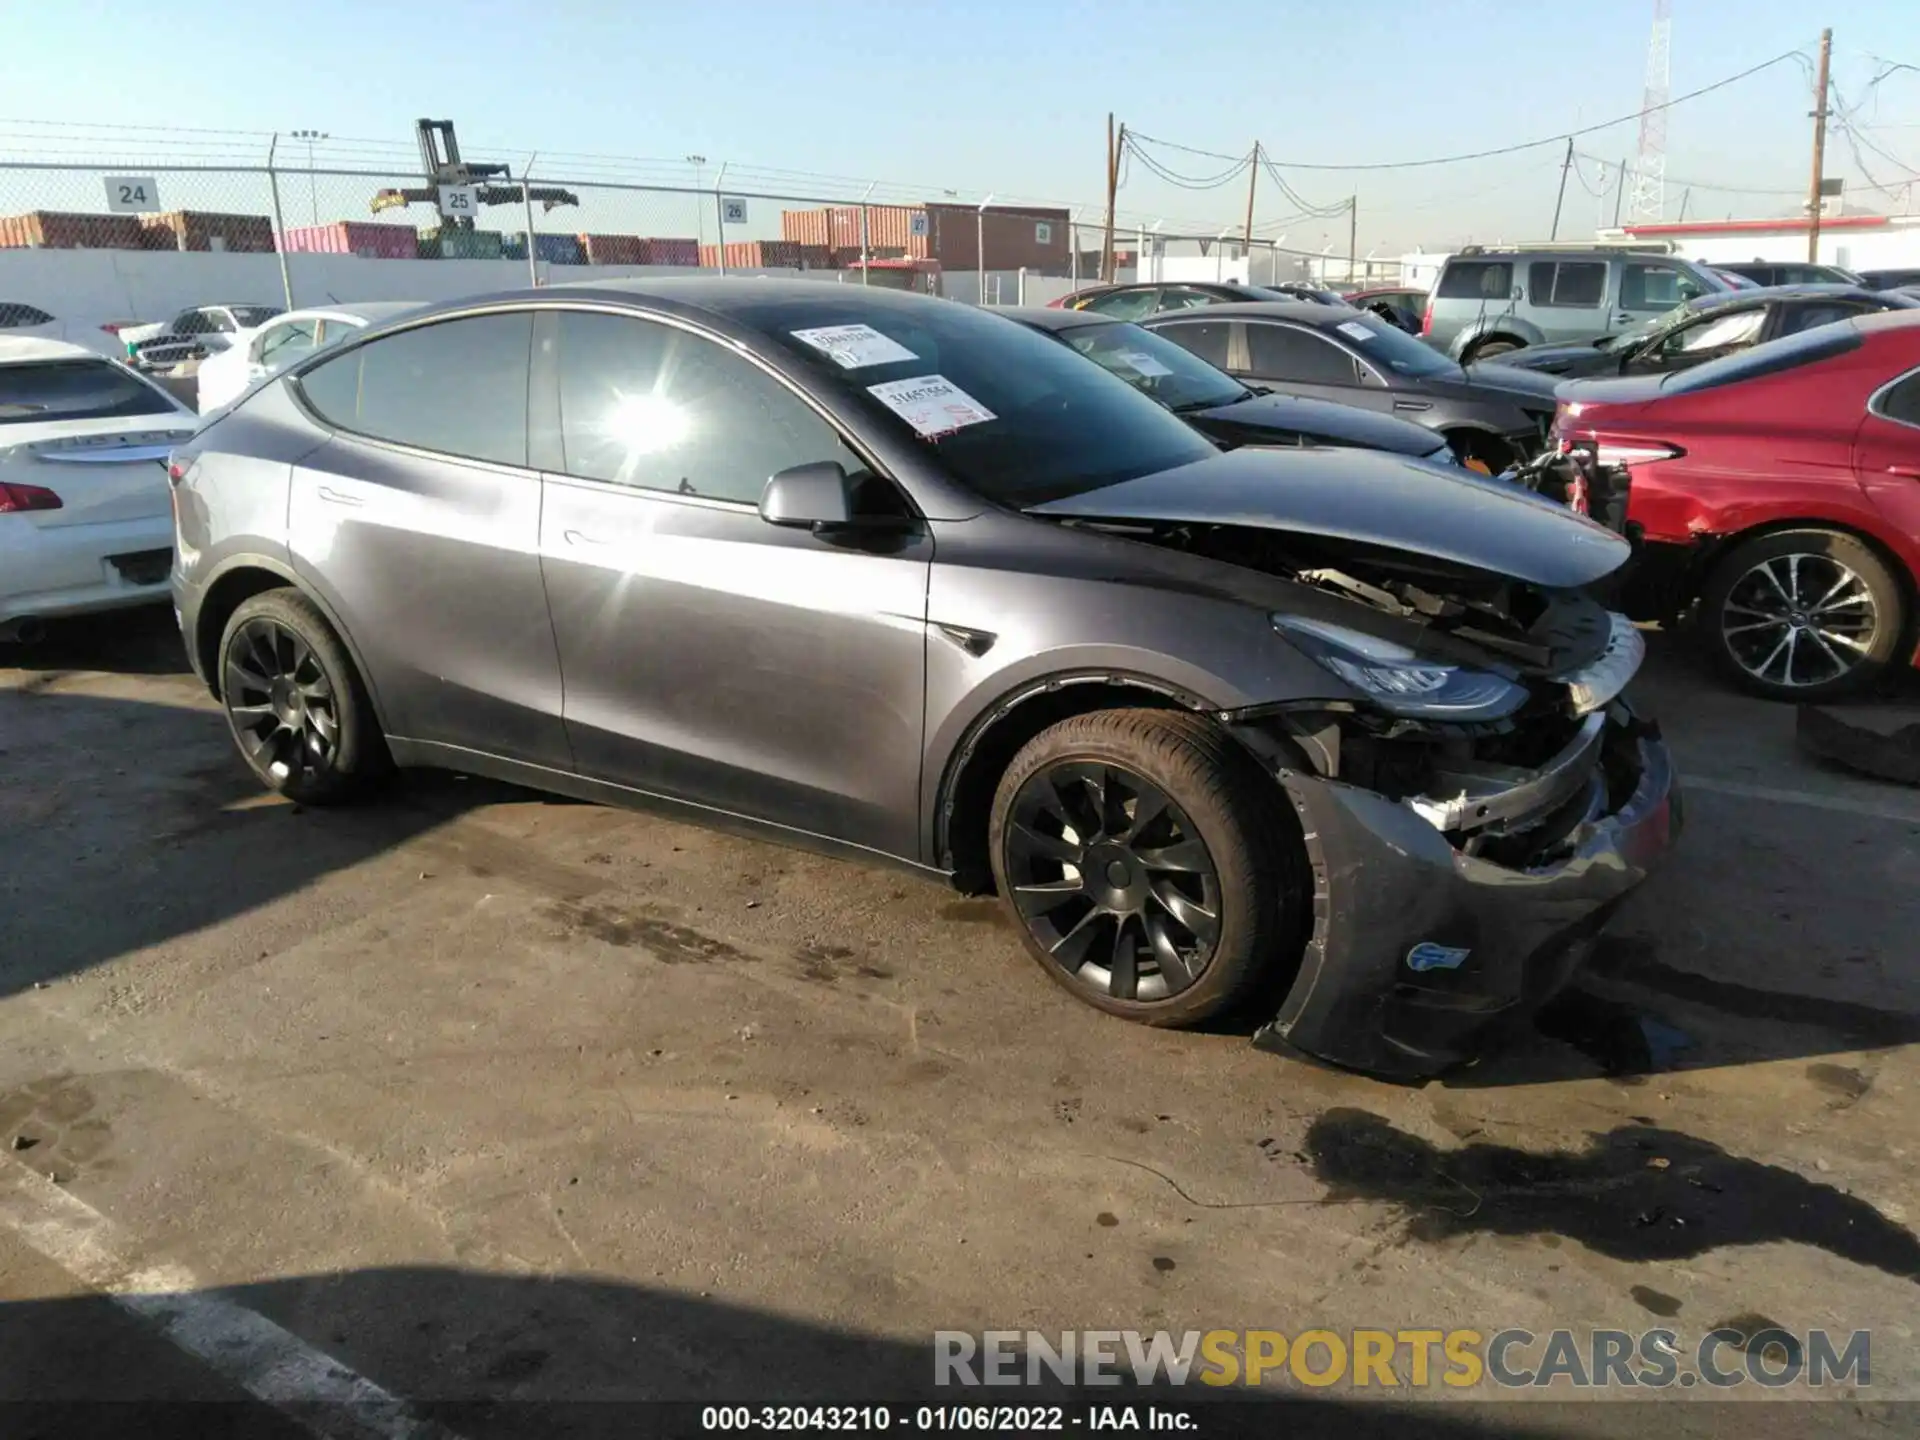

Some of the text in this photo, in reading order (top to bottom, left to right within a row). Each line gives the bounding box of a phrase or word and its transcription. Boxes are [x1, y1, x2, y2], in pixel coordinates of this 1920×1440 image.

[119, 185, 147, 204] 24
[449, 193, 469, 209] 25
[727, 204, 742, 218] 26
[914, 219, 925, 232] 27
